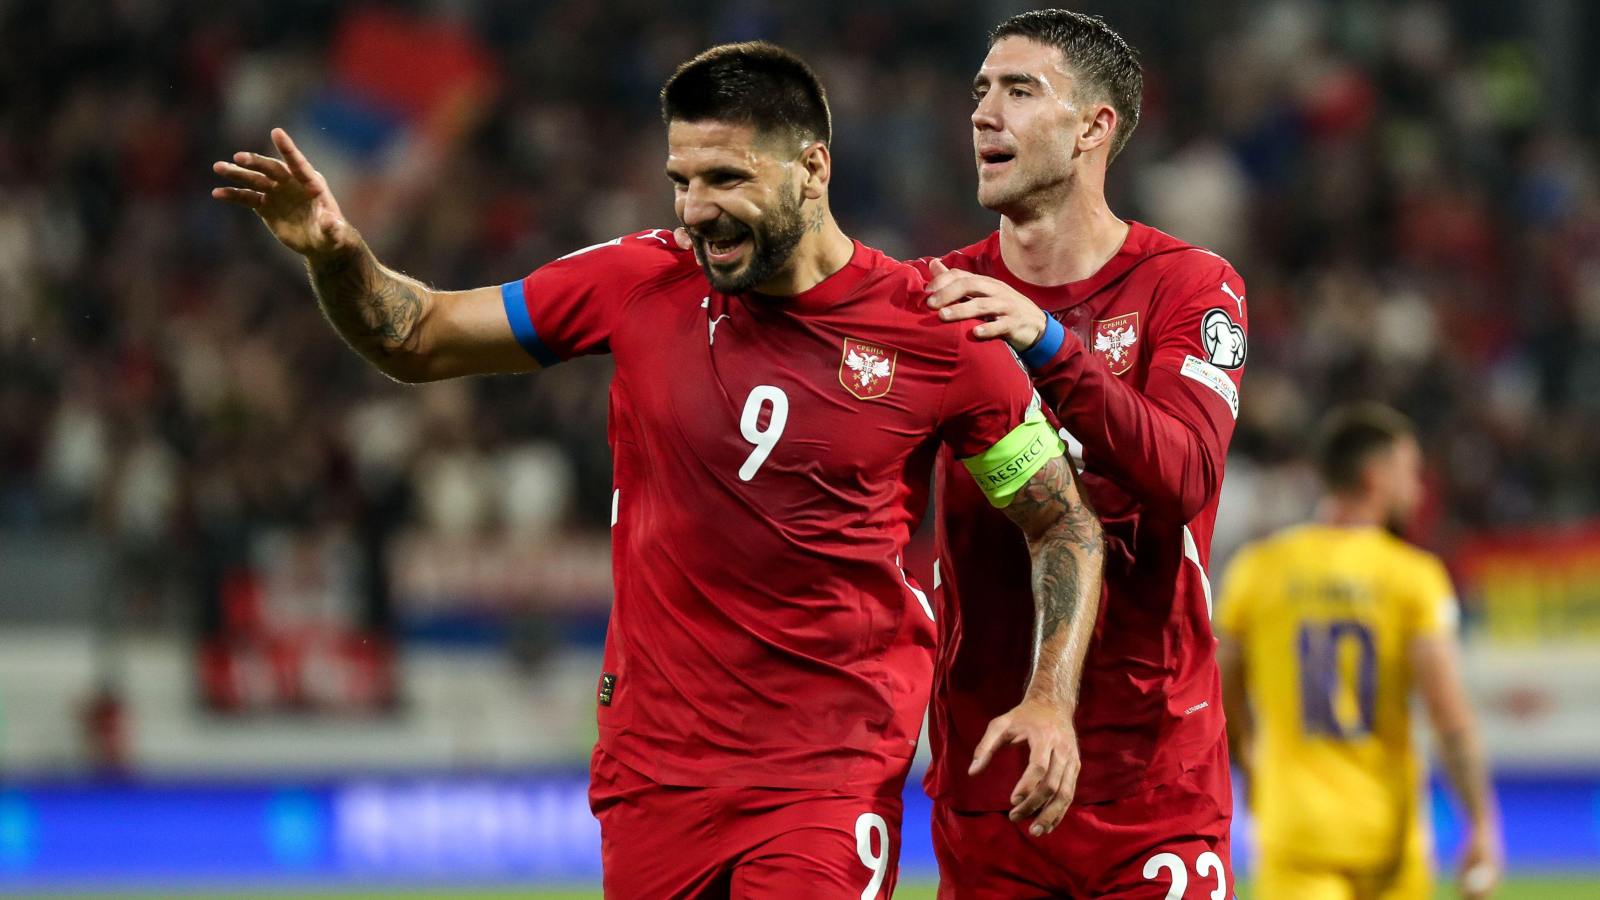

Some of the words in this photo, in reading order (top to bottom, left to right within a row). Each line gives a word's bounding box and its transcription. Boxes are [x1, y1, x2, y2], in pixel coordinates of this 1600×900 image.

[738, 385, 789, 482] 9
[987, 436, 1044, 485] RESPECT
[855, 813, 889, 900] 9
